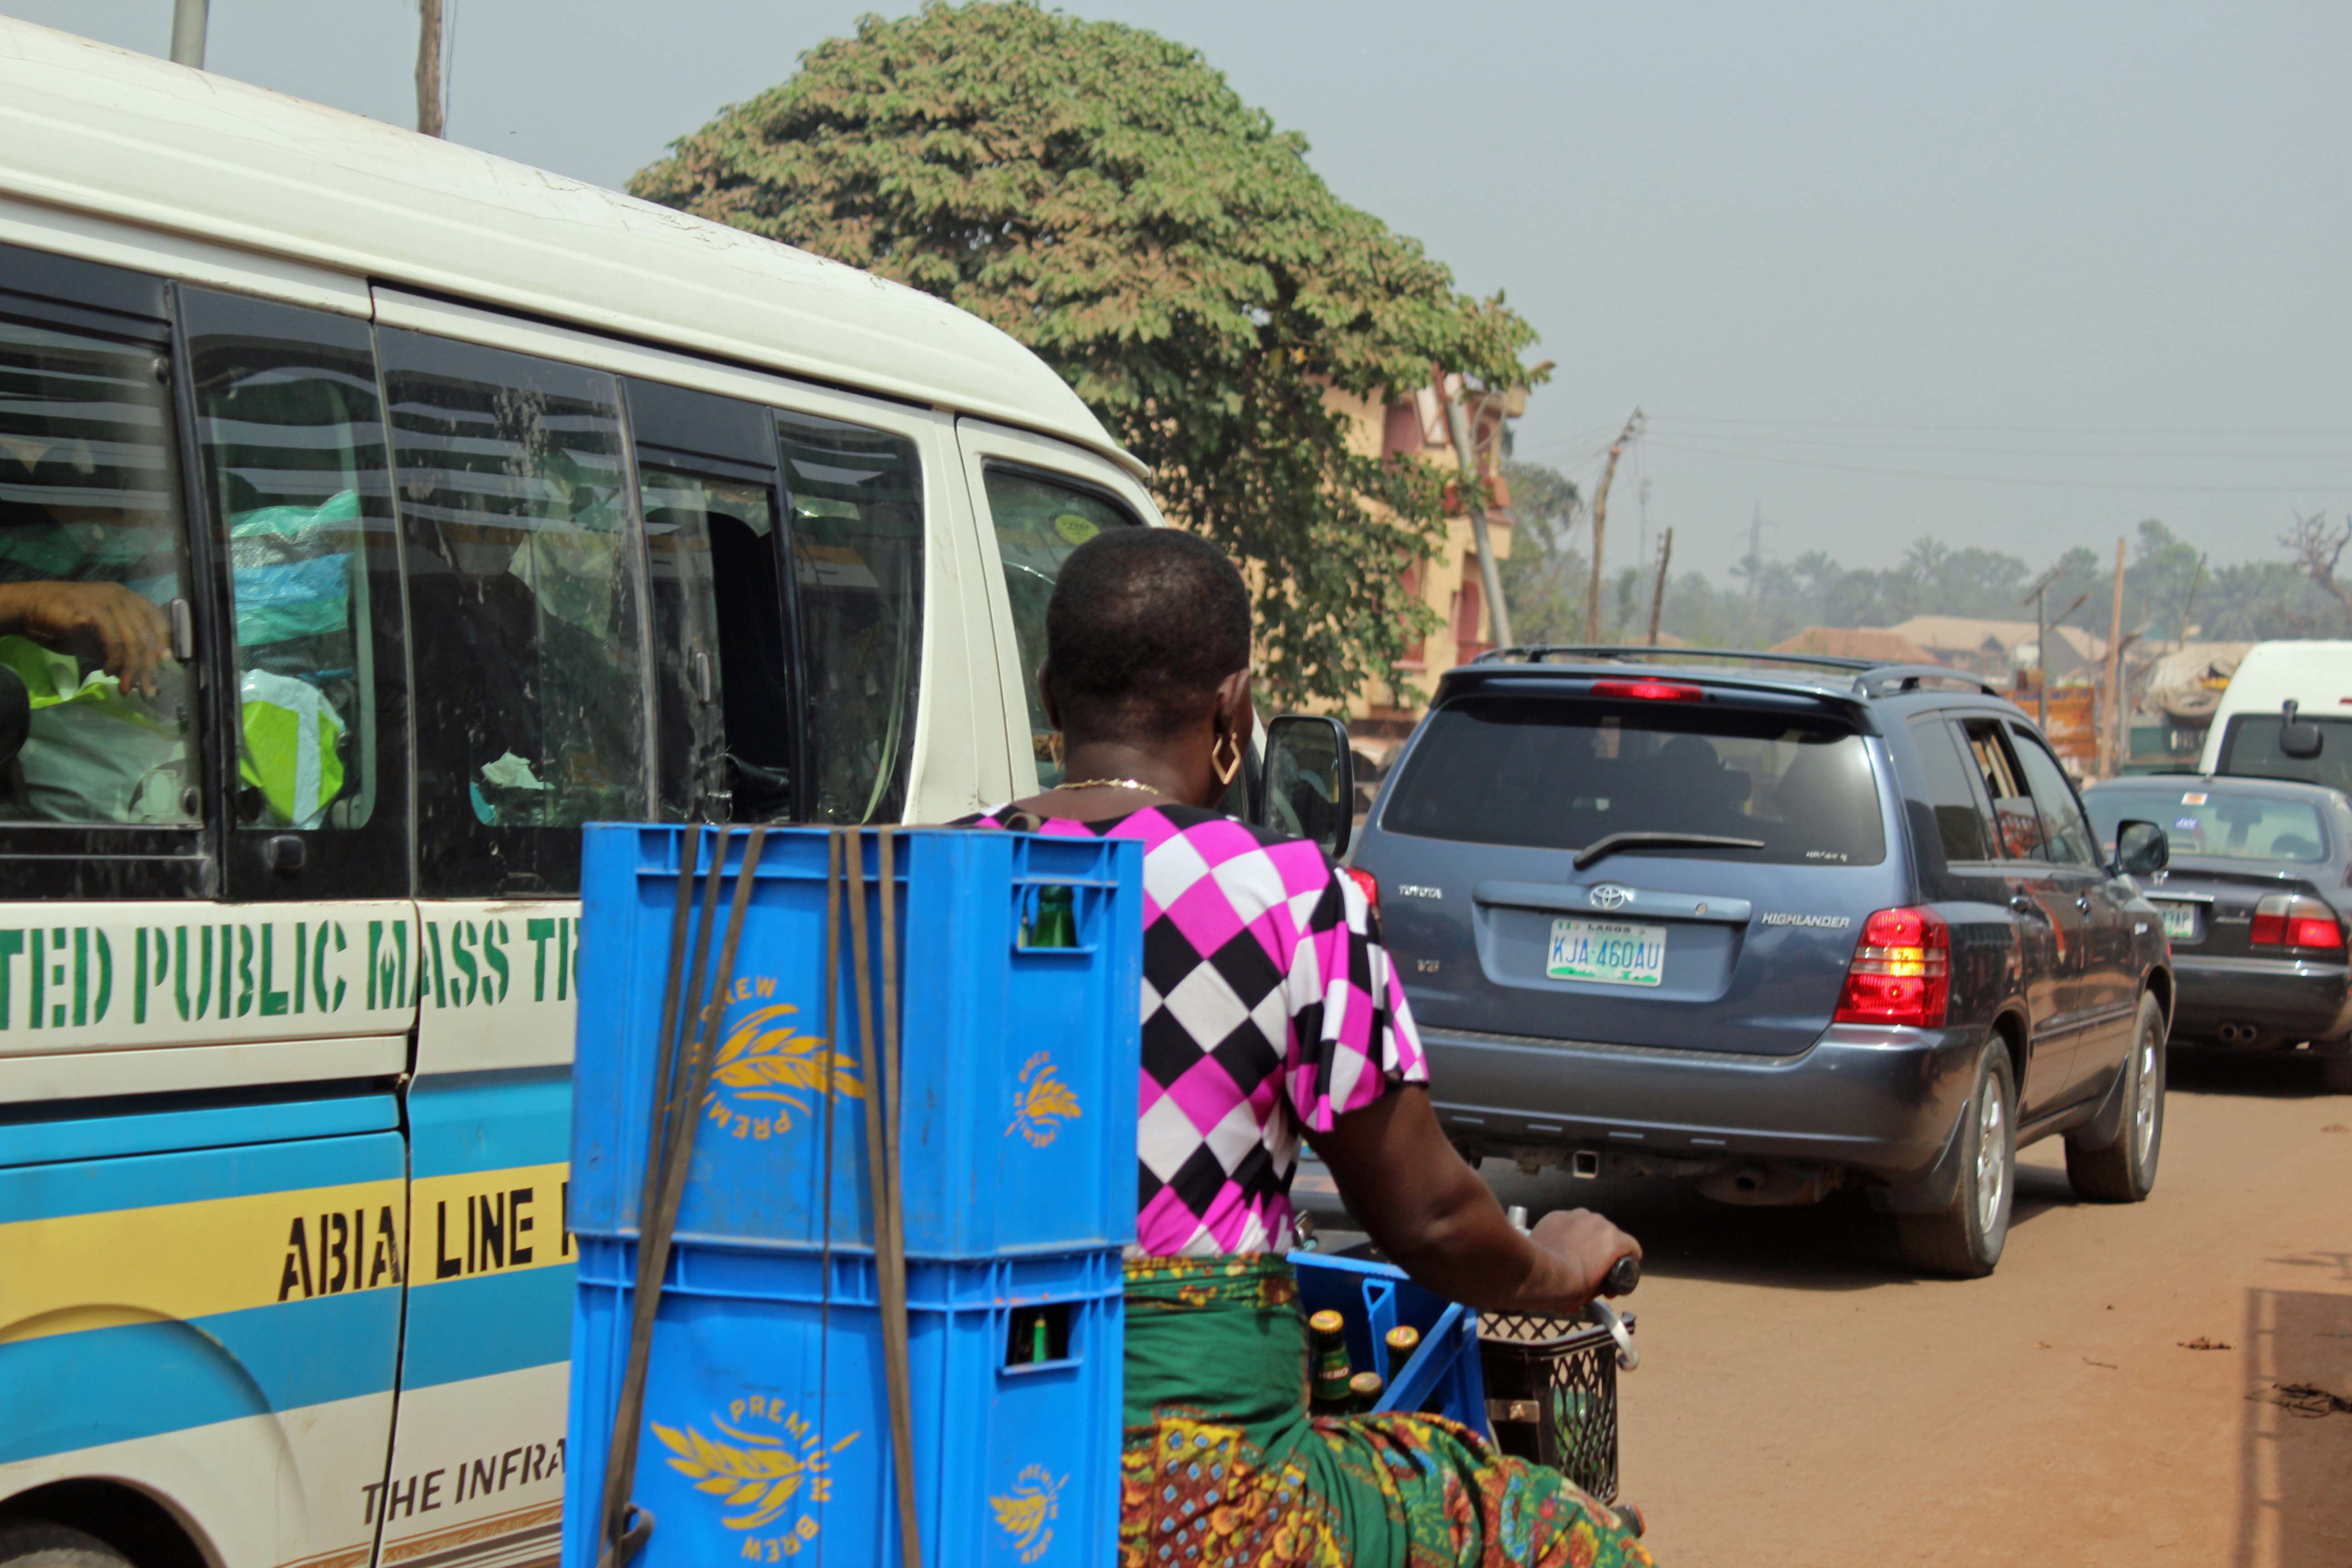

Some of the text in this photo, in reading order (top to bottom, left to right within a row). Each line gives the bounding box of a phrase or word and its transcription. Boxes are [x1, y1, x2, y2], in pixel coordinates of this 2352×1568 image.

[1399, 884, 1442, 899] TOYOTA
[1588, 923, 1631, 933] LAGOS
[1761, 912, 1850, 928] HIGHLANDER
[133, 919, 347, 1024] PUBLIC
[367, 919, 509, 1010] MASS
[277, 1205, 402, 1302] ABIA
[436, 1187, 533, 1279] LINE
[729, 1395, 832, 1503] PREMIUM
[362, 1468, 446, 1526] THE
[740, 1514, 820, 1563] BREW
